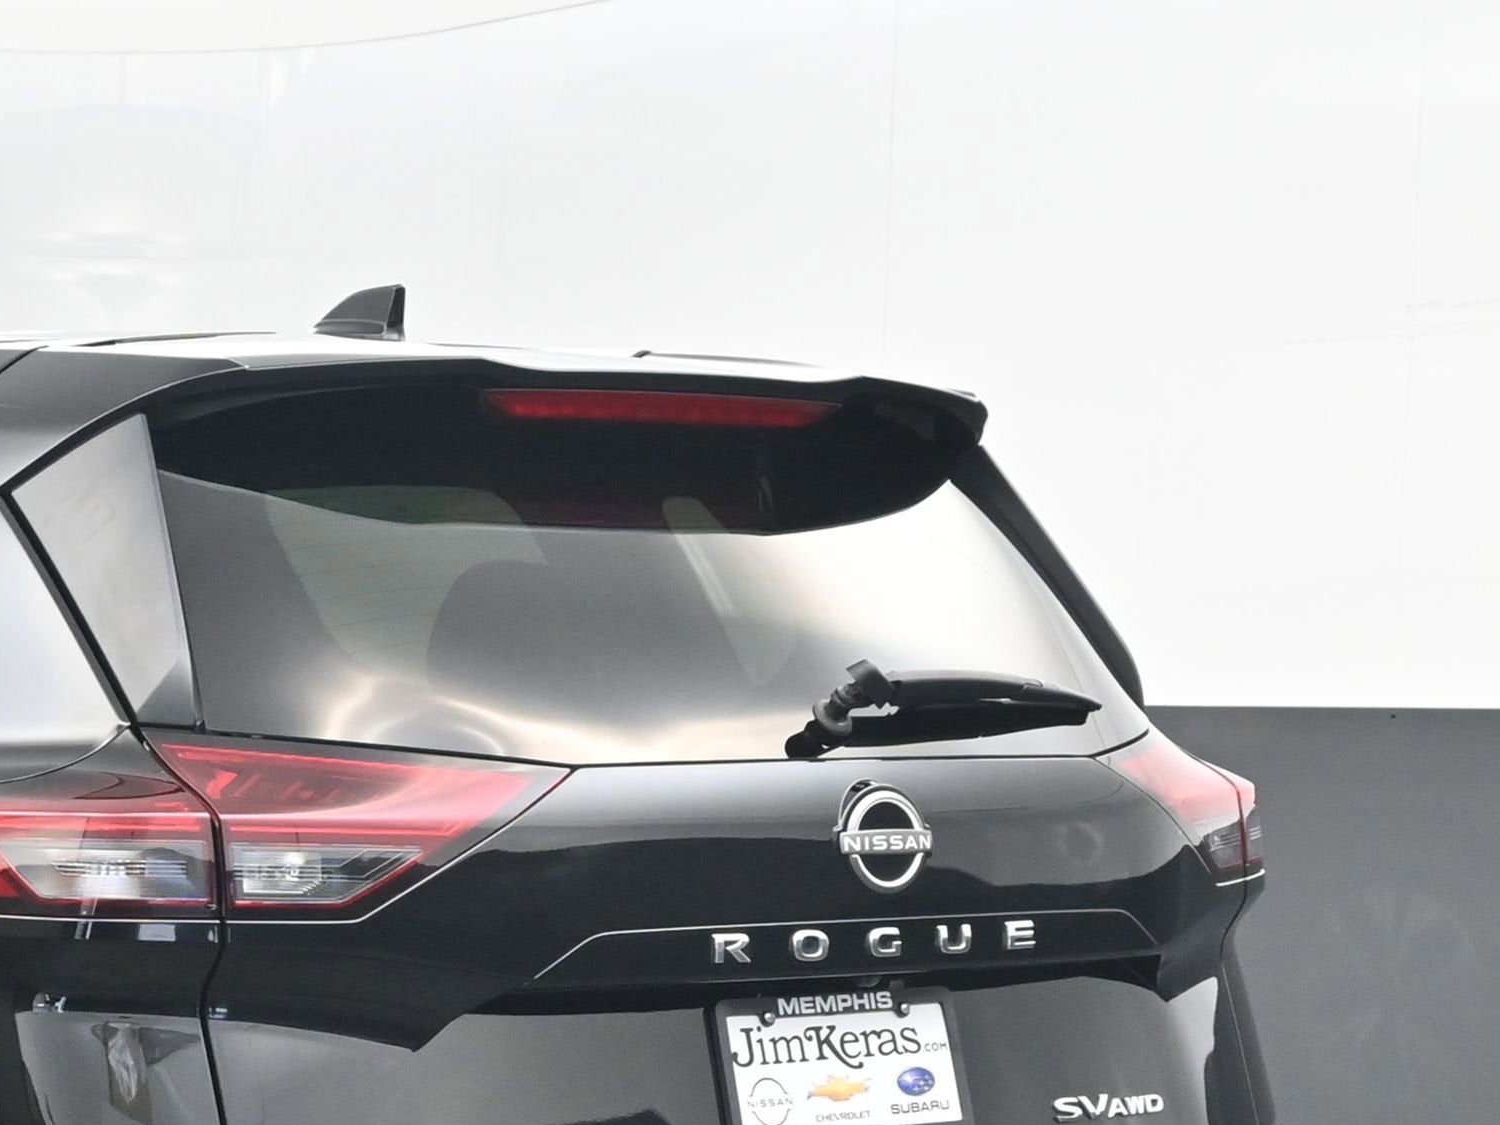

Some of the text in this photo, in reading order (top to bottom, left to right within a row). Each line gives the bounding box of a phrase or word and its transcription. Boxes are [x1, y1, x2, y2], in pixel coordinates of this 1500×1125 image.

[843, 834, 931, 852] NISSAN
[711, 919, 1036, 963] ROGUE
[777, 991, 893, 1016] MEMPHIS
[815, 1110, 871, 1123] CHEVROLET
[890, 1100, 950, 1115] SUBARU
